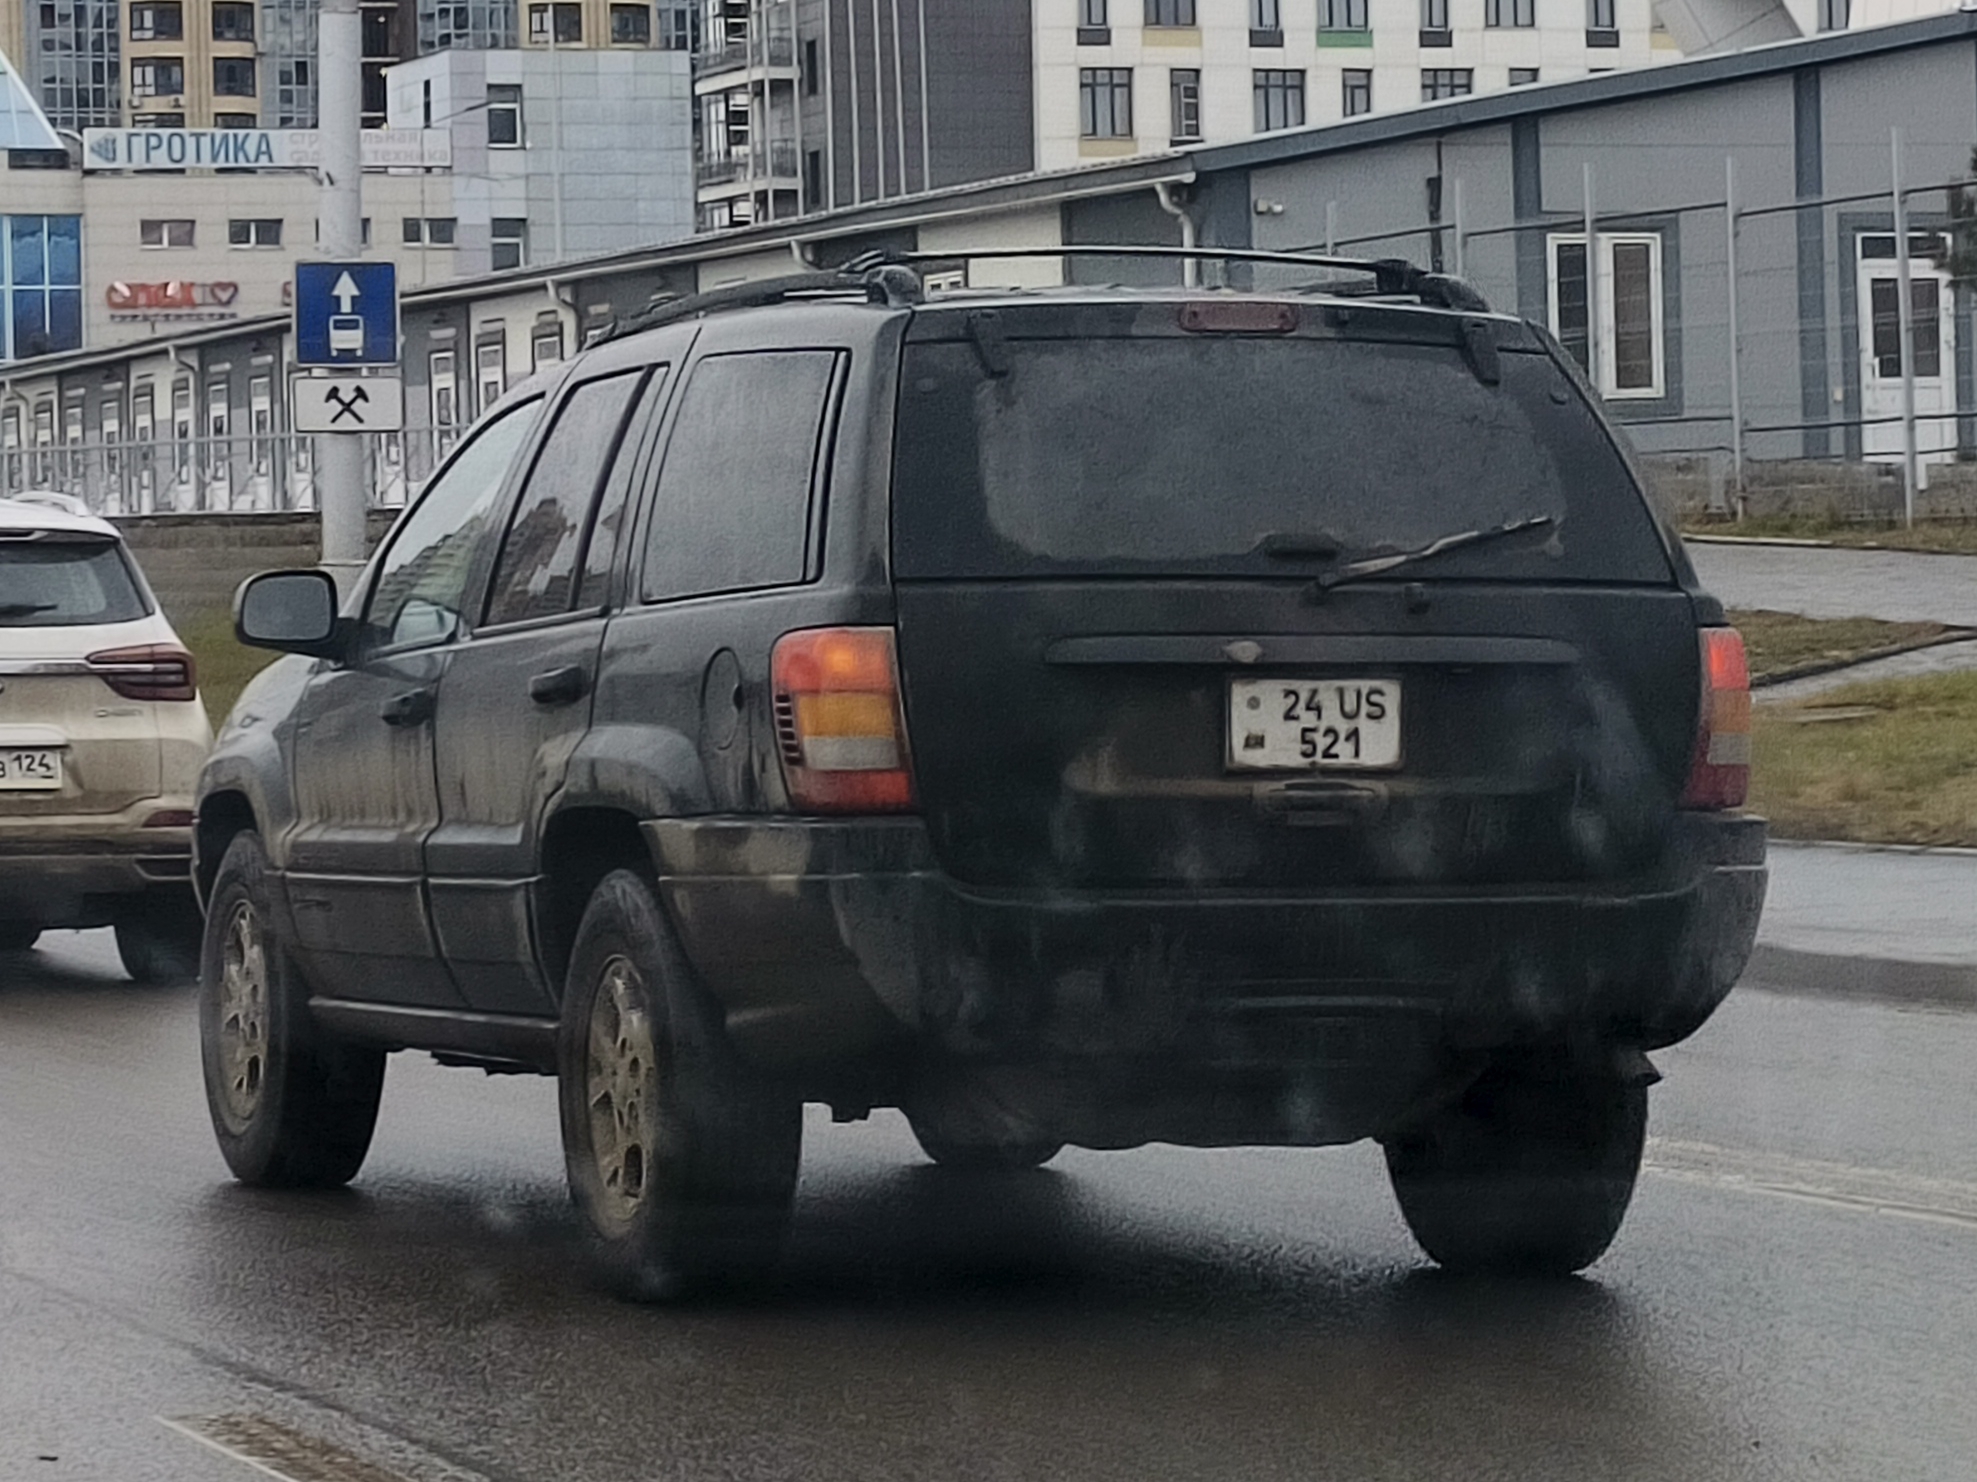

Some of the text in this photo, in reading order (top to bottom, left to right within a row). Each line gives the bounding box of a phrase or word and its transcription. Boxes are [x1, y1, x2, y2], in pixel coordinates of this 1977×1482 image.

[126, 132, 274, 163] ГРОТИКА
[1282, 686, 1386, 721] 24 US
[1300, 726, 1360, 759] 521
[11, 753, 53, 773] 124
